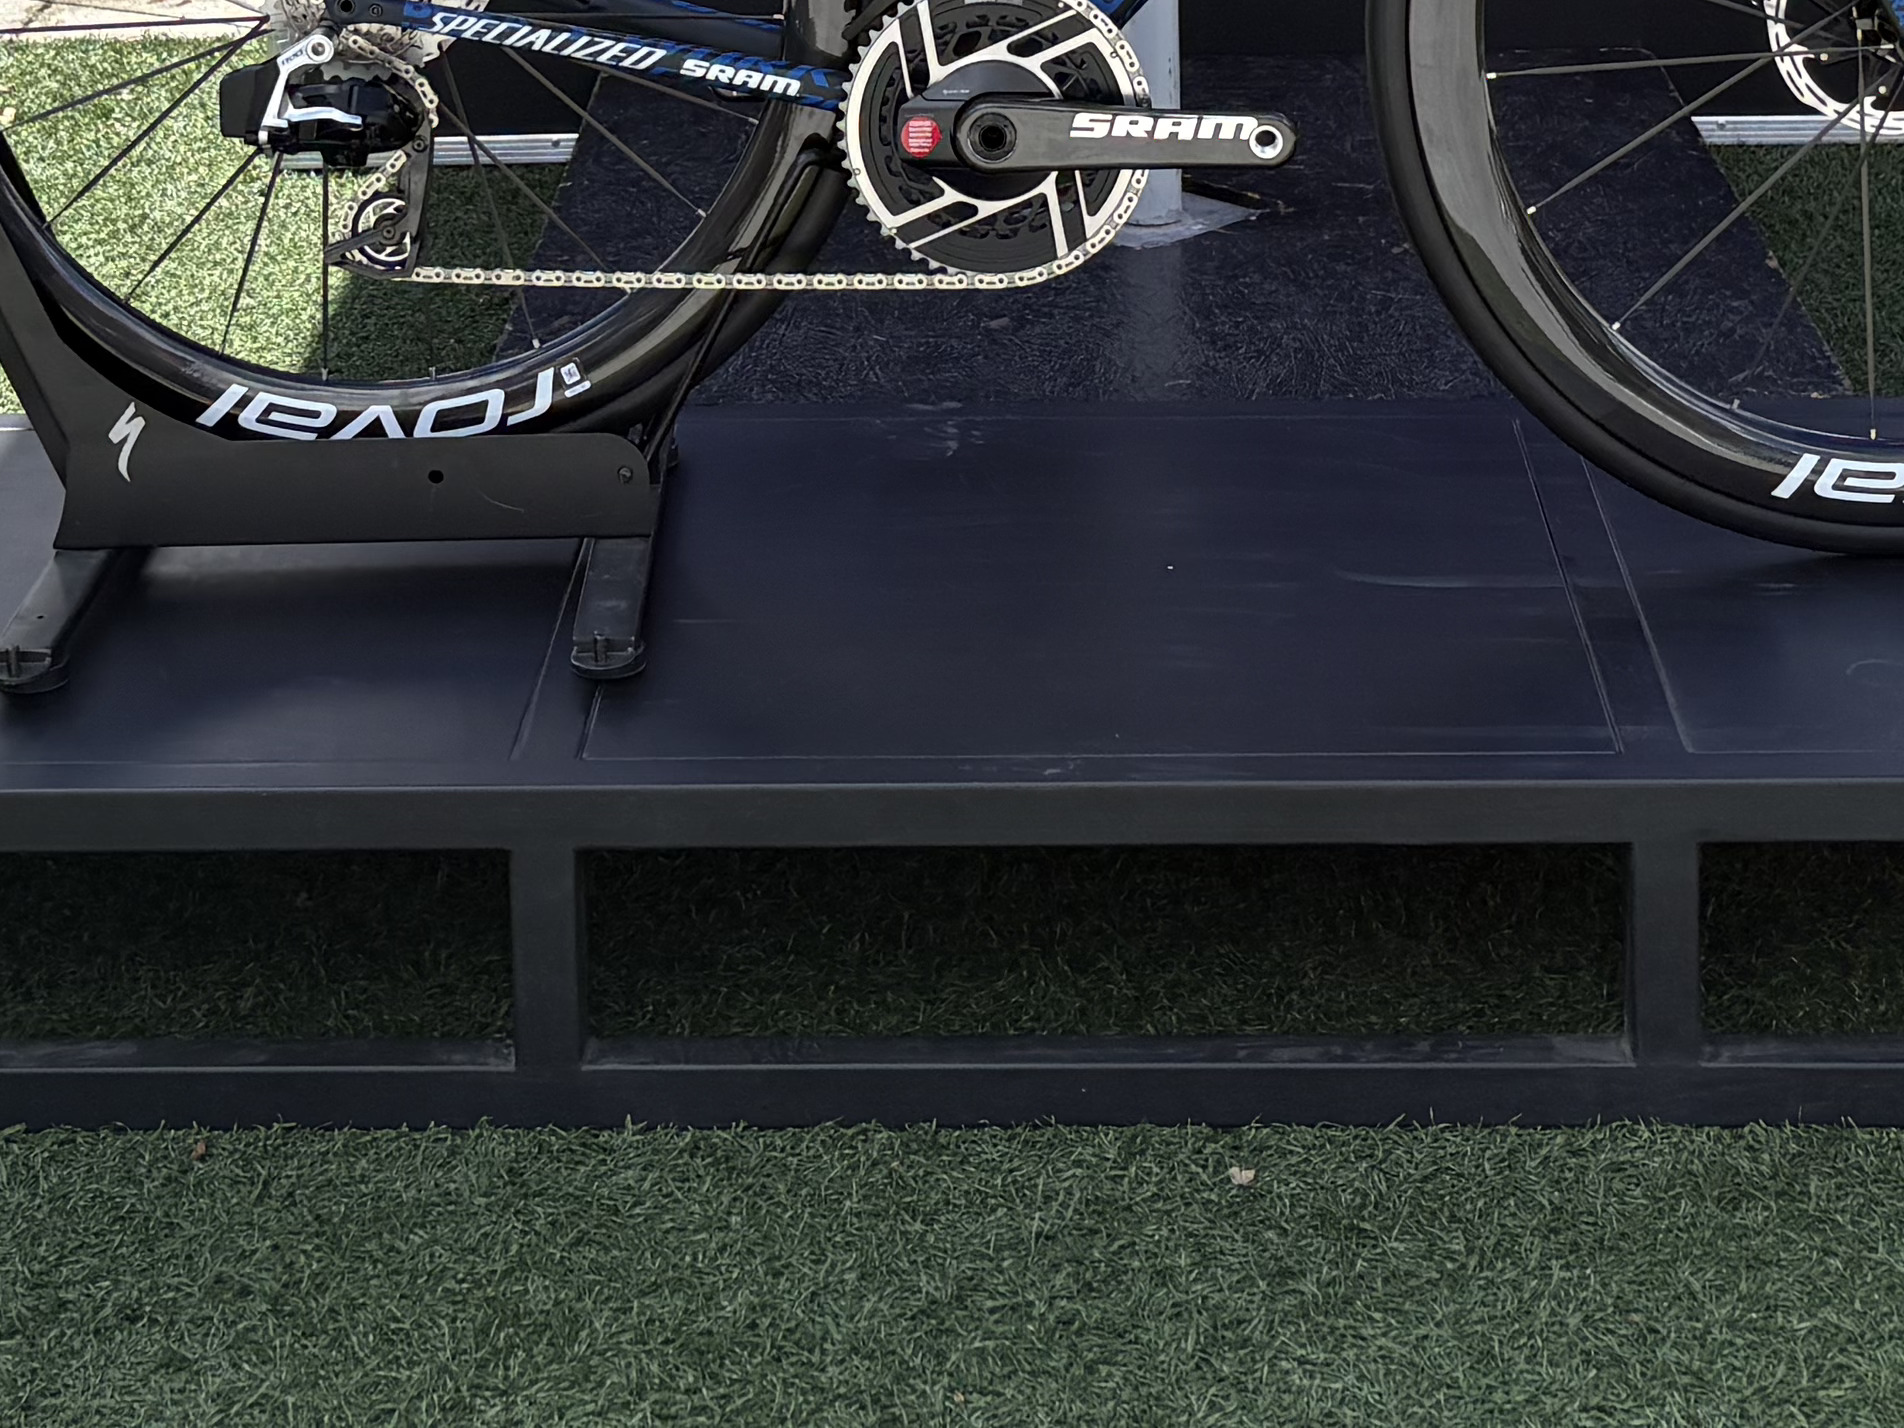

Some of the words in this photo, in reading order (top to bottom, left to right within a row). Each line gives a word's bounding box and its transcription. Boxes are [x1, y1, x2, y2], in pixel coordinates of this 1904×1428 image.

[419, 11, 668, 72] SPECIALIZED
[680, 58, 802, 96] SRAM
[1069, 112, 1259, 141] SRAM
[196, 366, 555, 441] roval
